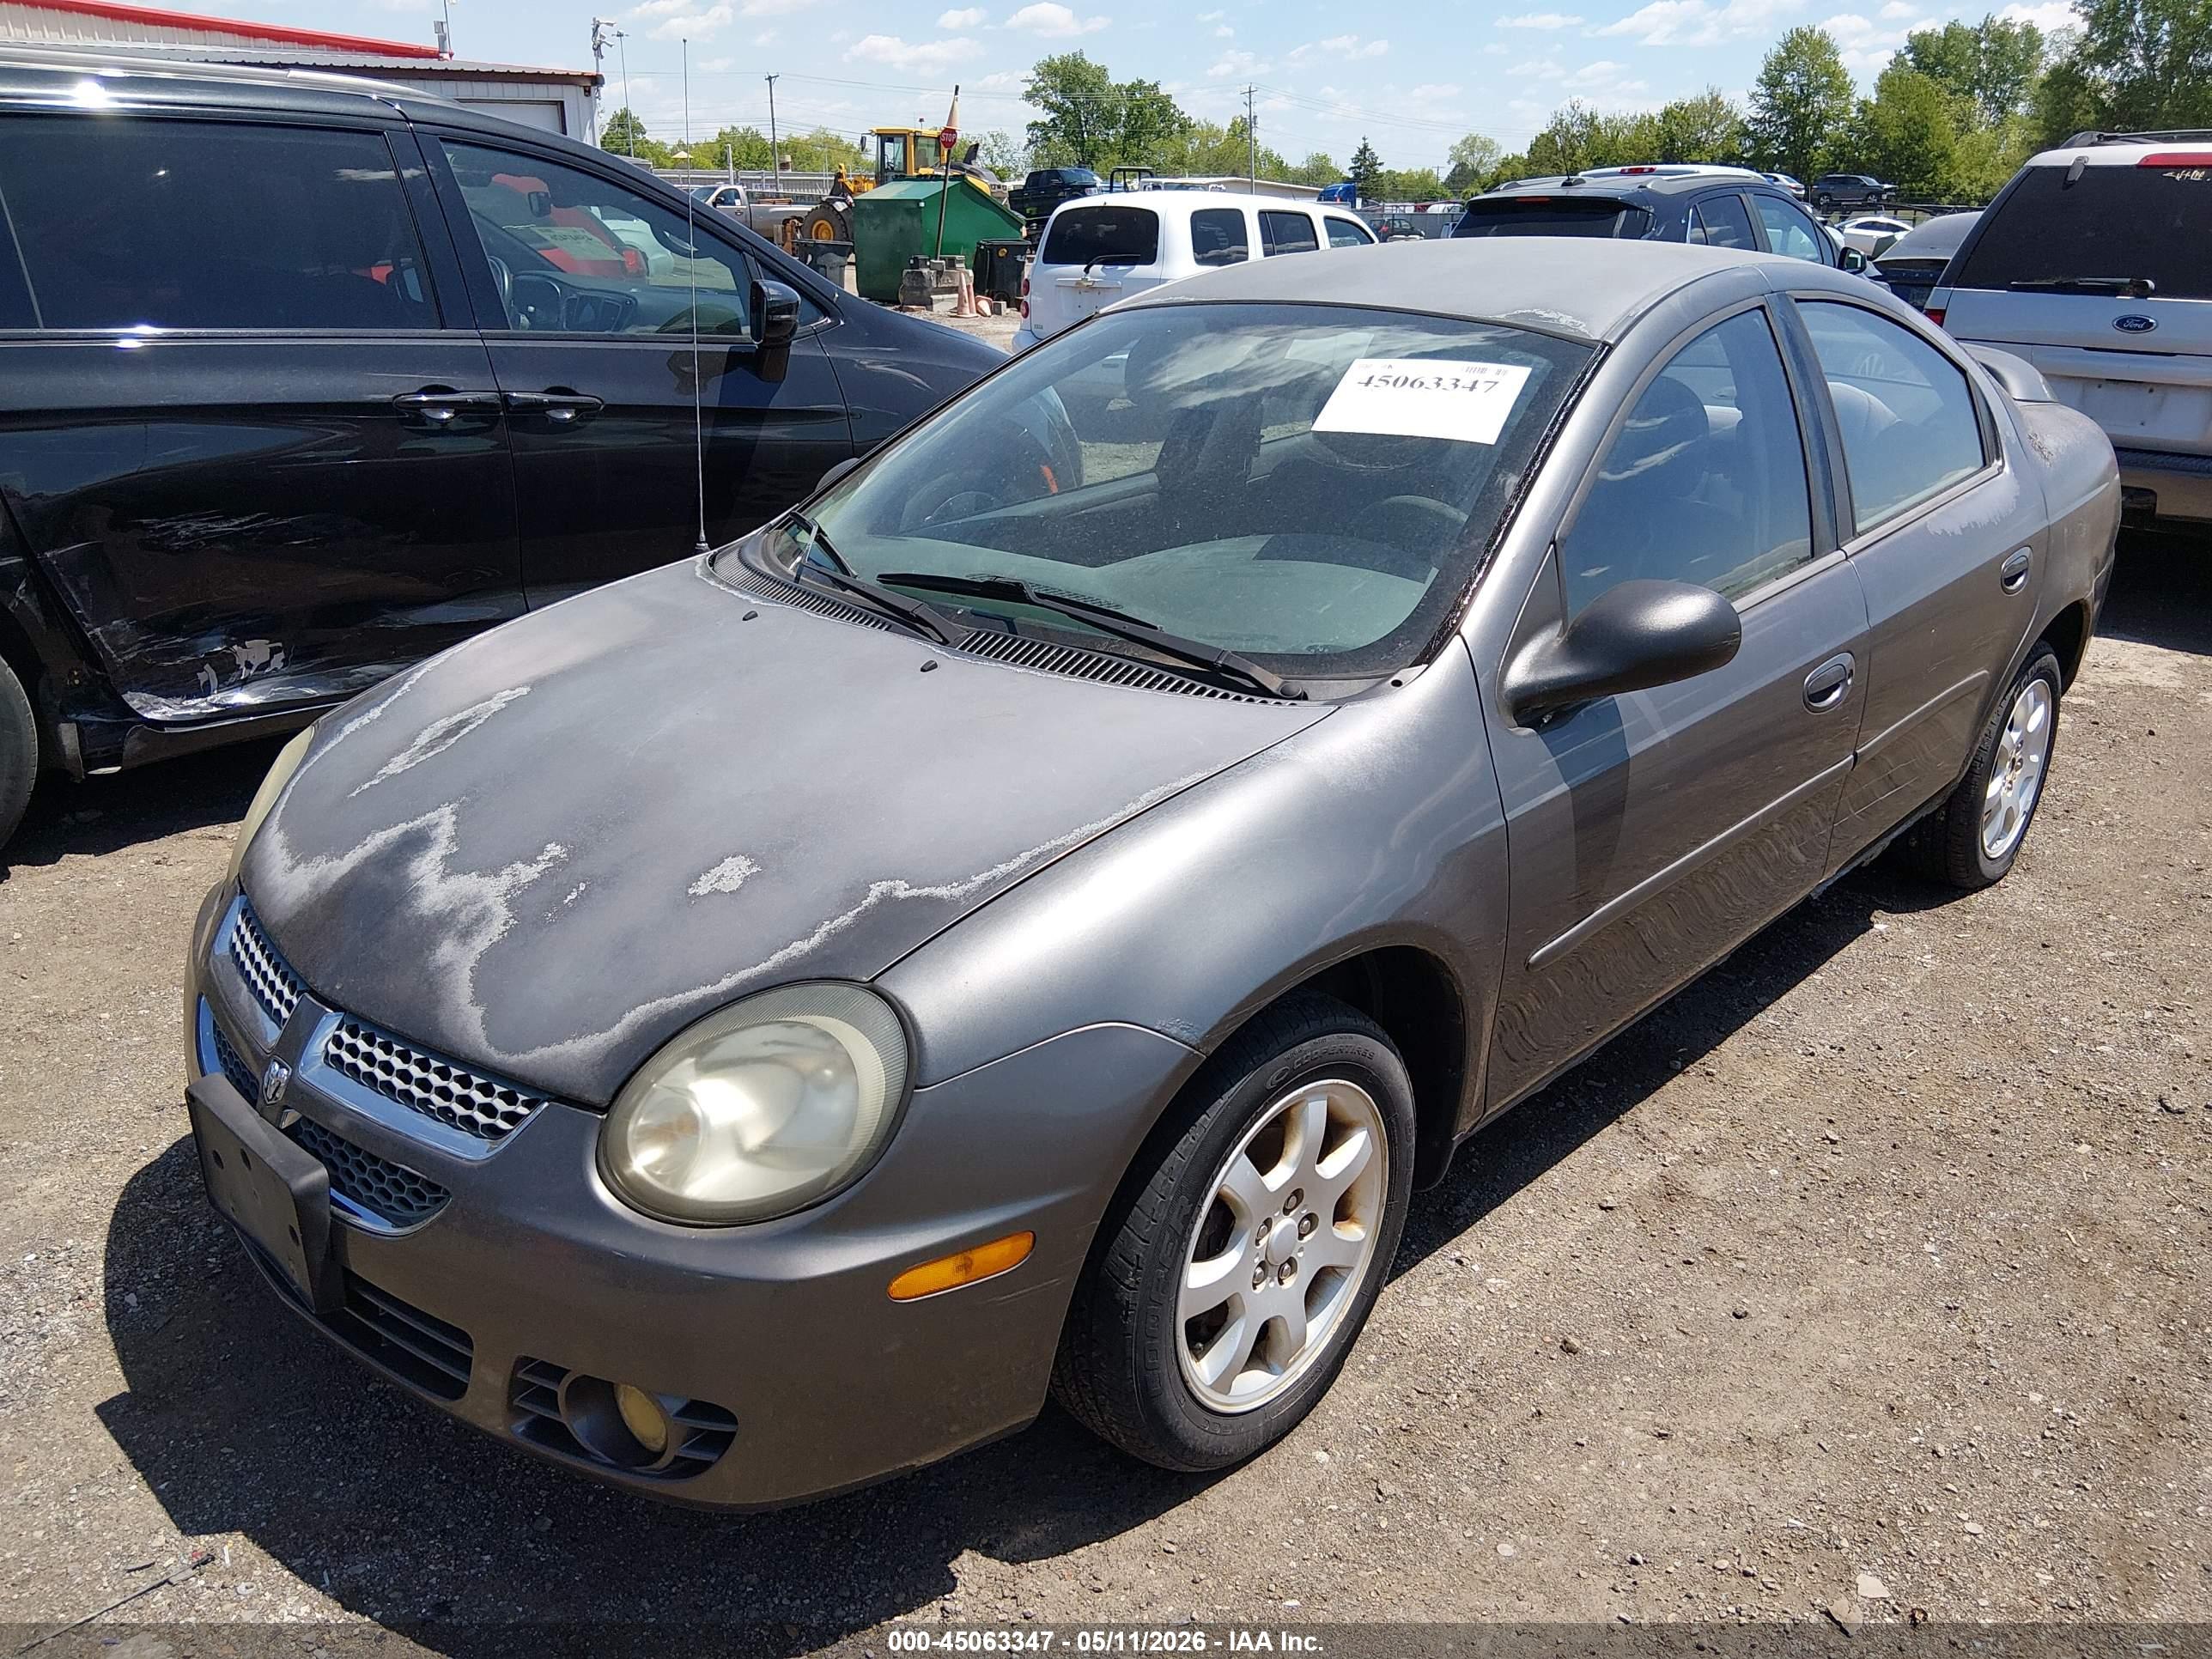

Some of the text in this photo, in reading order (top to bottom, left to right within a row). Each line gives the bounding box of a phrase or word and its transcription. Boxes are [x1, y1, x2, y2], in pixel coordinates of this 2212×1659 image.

[941, 133, 956, 143] STOP
[2124, 319, 2147, 328] Ford
[1358, 375, 1498, 392] 45063347
